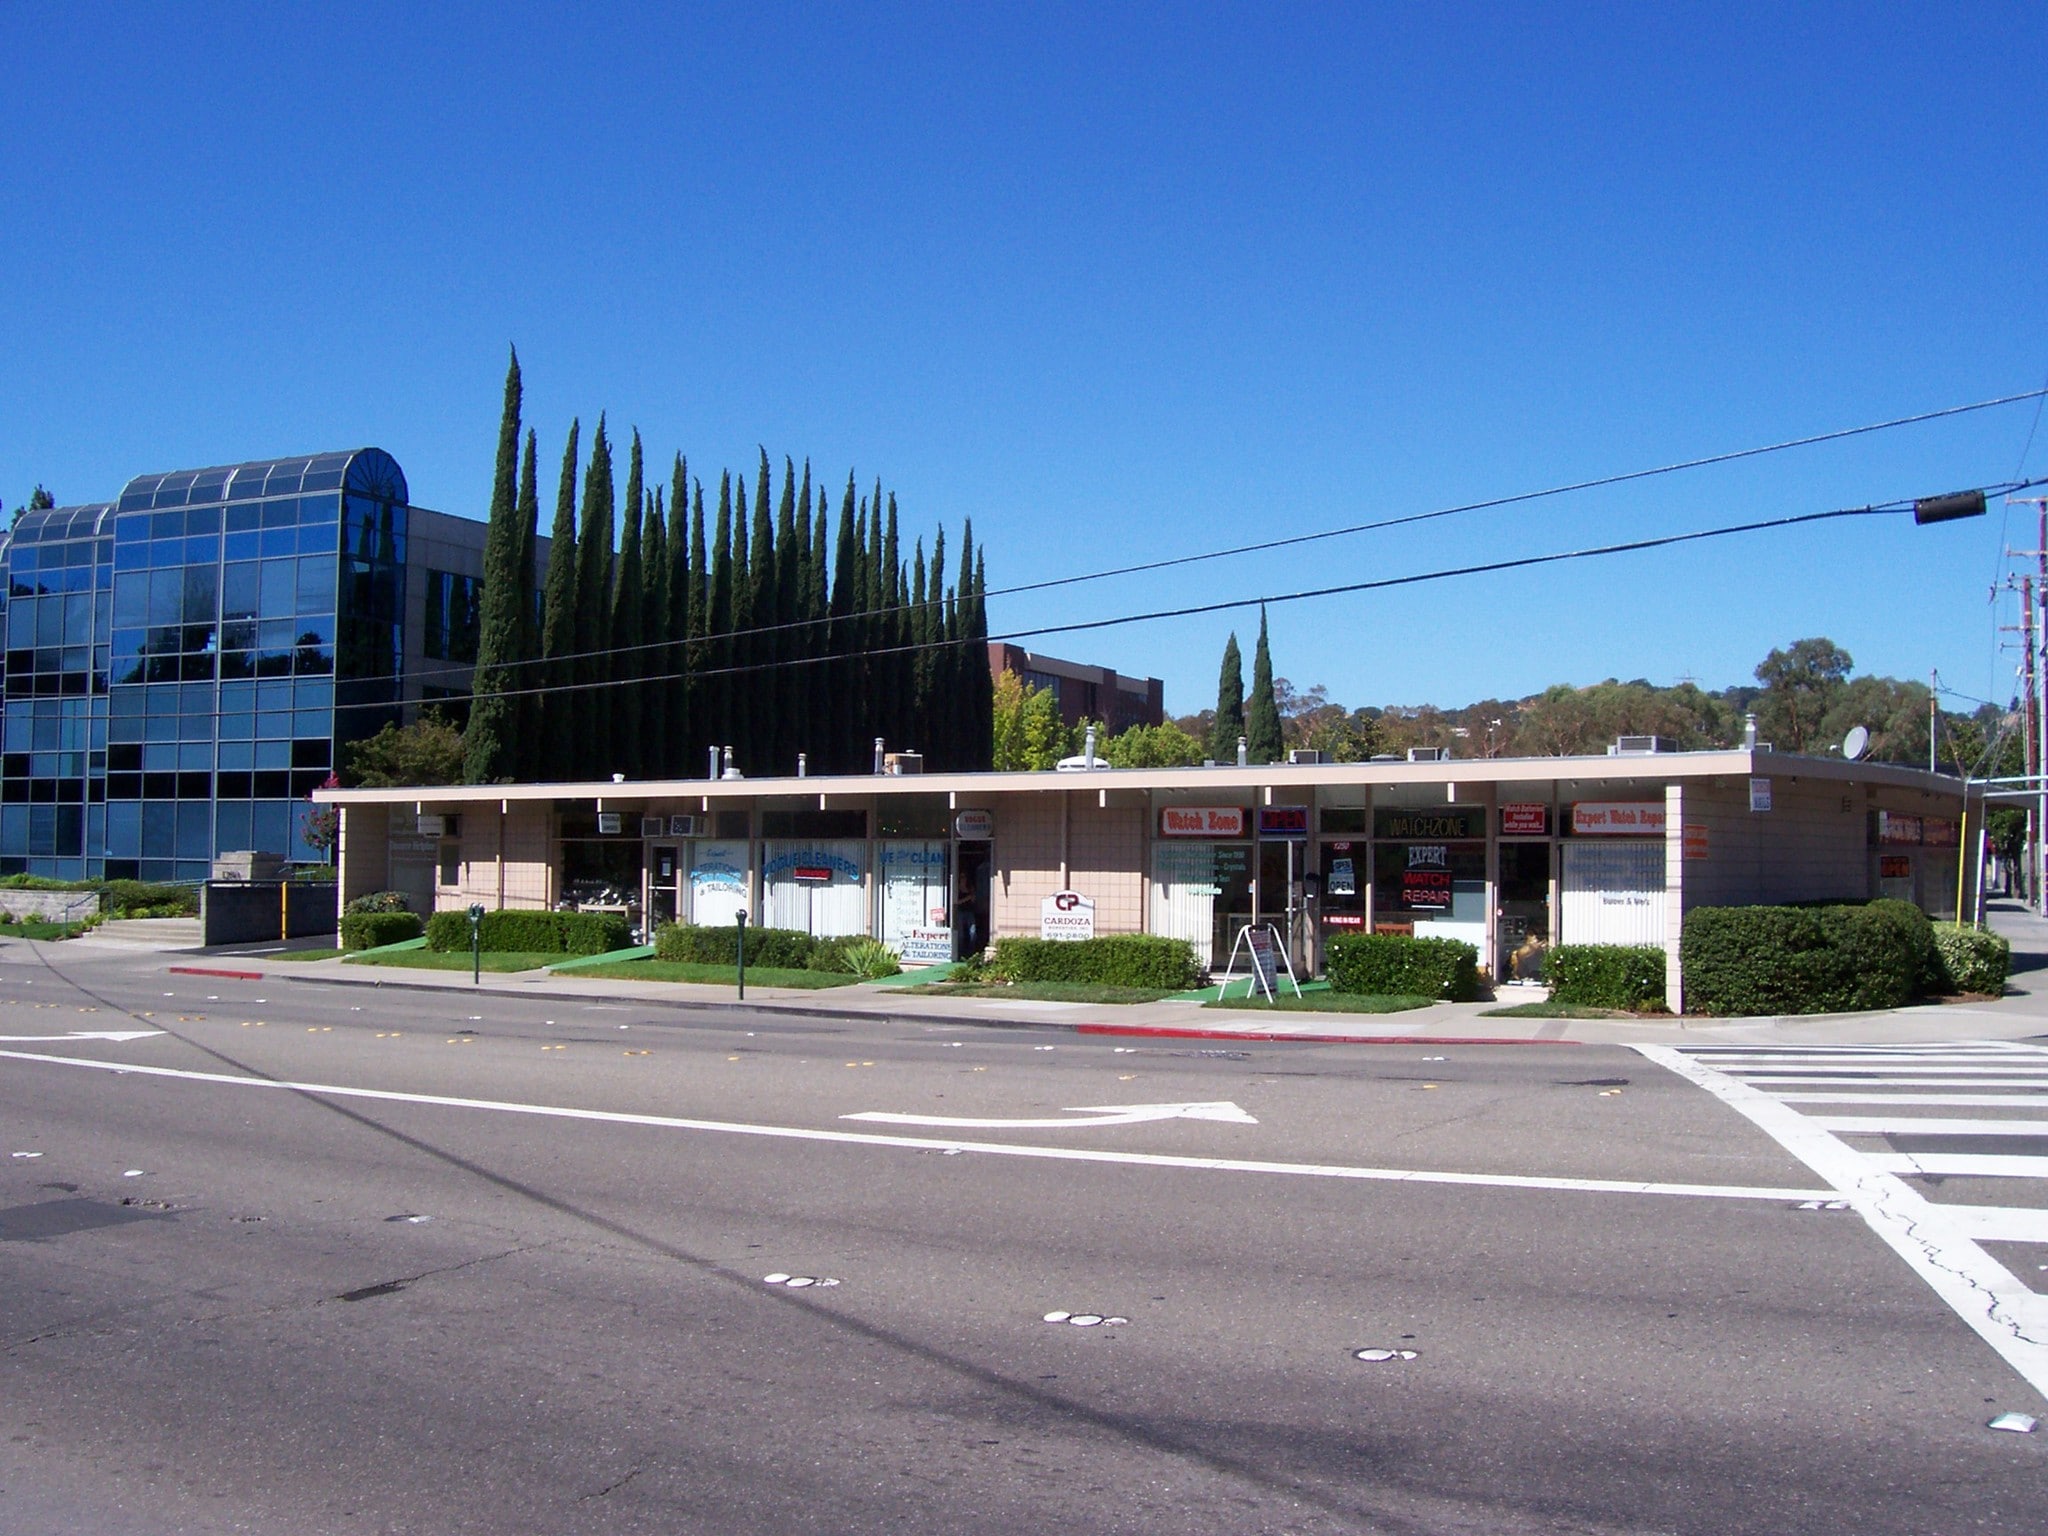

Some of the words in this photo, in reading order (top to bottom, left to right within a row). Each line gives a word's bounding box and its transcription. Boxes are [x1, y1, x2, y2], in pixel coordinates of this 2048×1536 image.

[1167, 811, 1204, 830] Watch
[1208, 811, 1239, 830] Zone
[1264, 810, 1306, 828] OPEN
[1575, 809, 1607, 828] Expert
[1609, 809, 1637, 825] Watch
[911, 852, 945, 864] CLEAN
[1408, 846, 1447, 867] EXPERT
[763, 852, 798, 877] VOGUE
[801, 851, 860, 881] CLEANERS
[1403, 872, 1450, 886] WATCH
[706, 882, 748, 898] TAILORING
[1329, 881, 1353, 892] OPEN
[1055, 893, 1080, 911] CP
[1402, 889, 1450, 903] REPAIR
[1043, 917, 1092, 926] CARDOZA
[912, 929, 949, 941] Expert
[901, 942, 951, 951] ALTERATIONS
[911, 950, 951, 960] TAILORING
